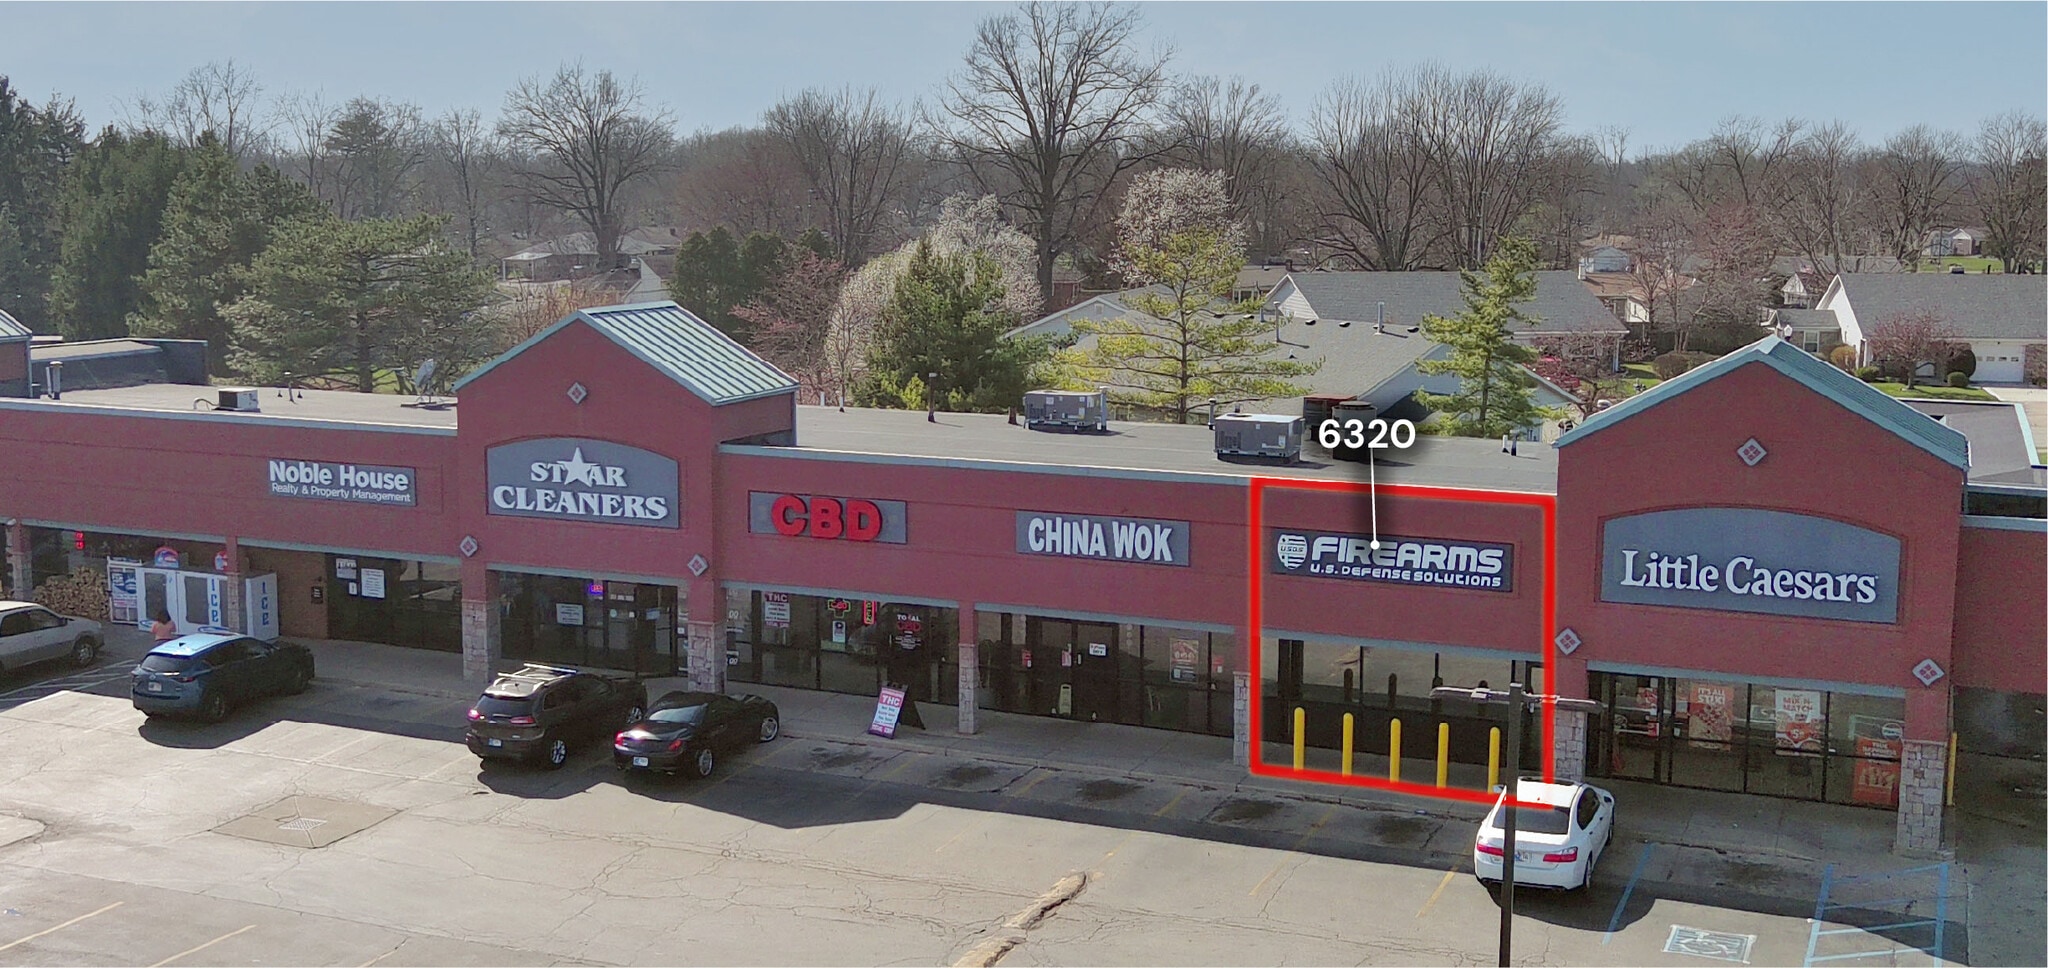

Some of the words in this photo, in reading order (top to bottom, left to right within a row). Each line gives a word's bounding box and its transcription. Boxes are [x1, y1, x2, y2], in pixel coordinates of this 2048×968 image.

[269, 460, 333, 485] Noble
[339, 465, 409, 491] House
[530, 461, 628, 487] STAR
[272, 482, 298, 496] Realty
[301, 485, 309, 495] &
[311, 486, 350, 499] Property
[352, 489, 411, 502] Management
[493, 485, 668, 520] CLEANERS
[771, 494, 883, 542] CBD
[1027, 517, 1105, 558] CHINA
[1111, 523, 1173, 563] WOK
[1311, 536, 1504, 574] FIREARMS
[1310, 563, 1338, 574] U.S.
[1341, 566, 1411, 581] DEFENSE
[1413, 571, 1501, 587] SOLUTIONS
[1620, 549, 1719, 593] Little
[1725, 555, 1877, 605] Caesars
[767, 593, 788, 602] THC
[881, 694, 900, 706] THC
